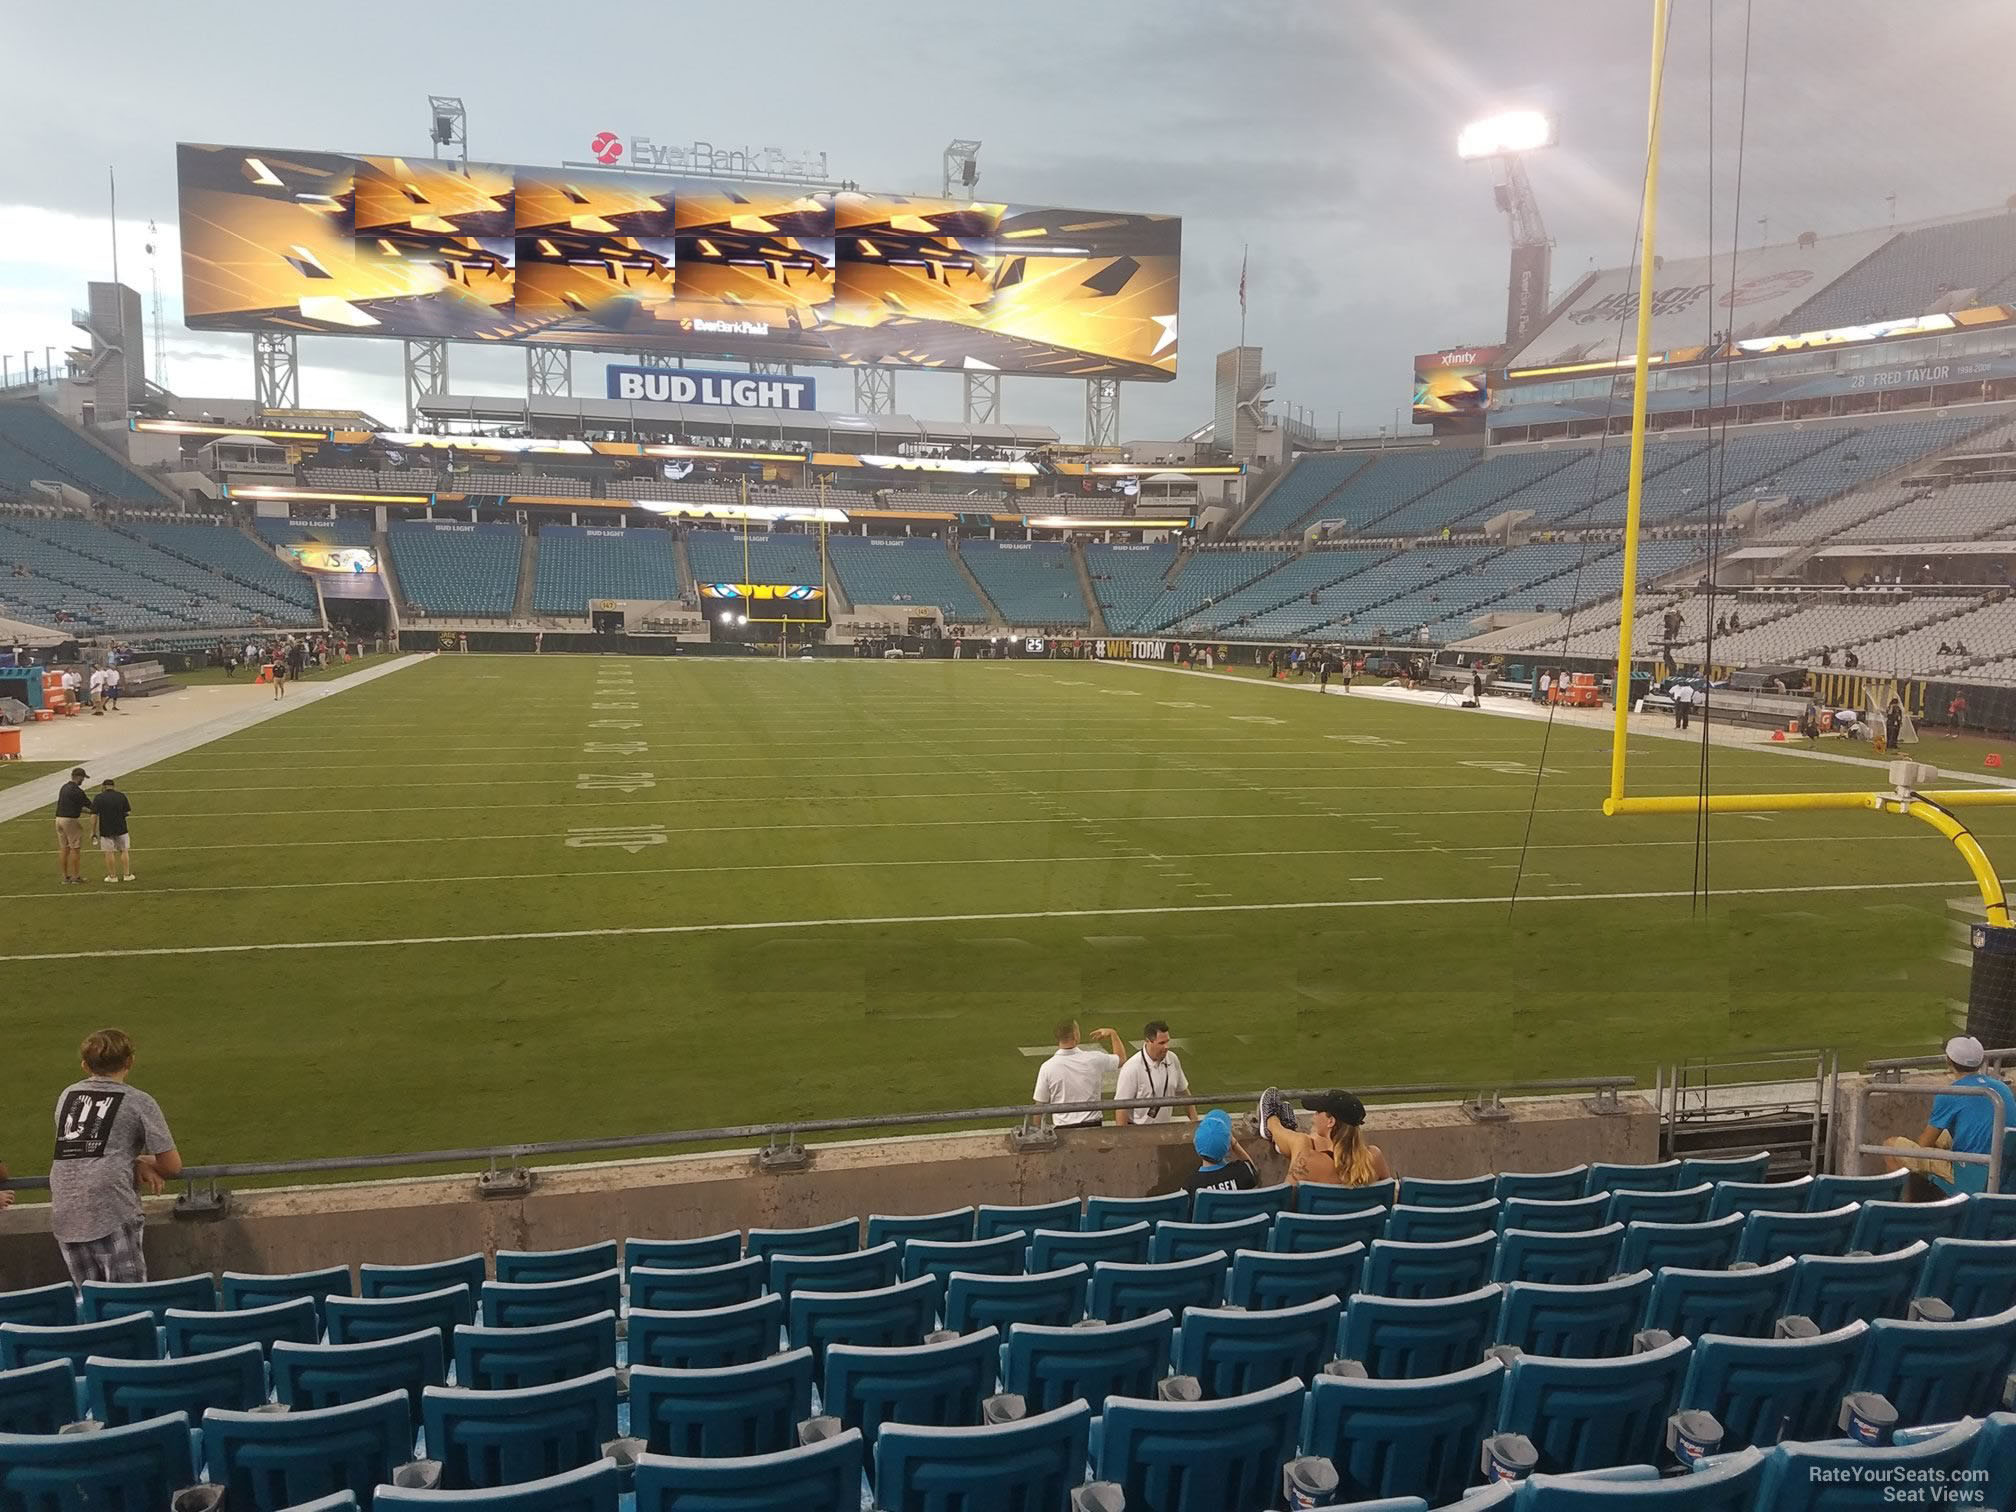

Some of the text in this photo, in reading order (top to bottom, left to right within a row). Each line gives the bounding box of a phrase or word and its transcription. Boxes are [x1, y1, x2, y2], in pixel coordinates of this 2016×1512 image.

[631, 136, 761, 173] EverBank
[1441, 351, 1477, 366] xfinity
[1851, 375, 1865, 388] 28
[1873, 371, 1901, 386] FRED
[1905, 365, 1949, 382] TAYLOR
[619, 373, 804, 408] BUD LIGHT
[1028, 639, 1042, 651] 25
[564, 824, 669, 848] 10
